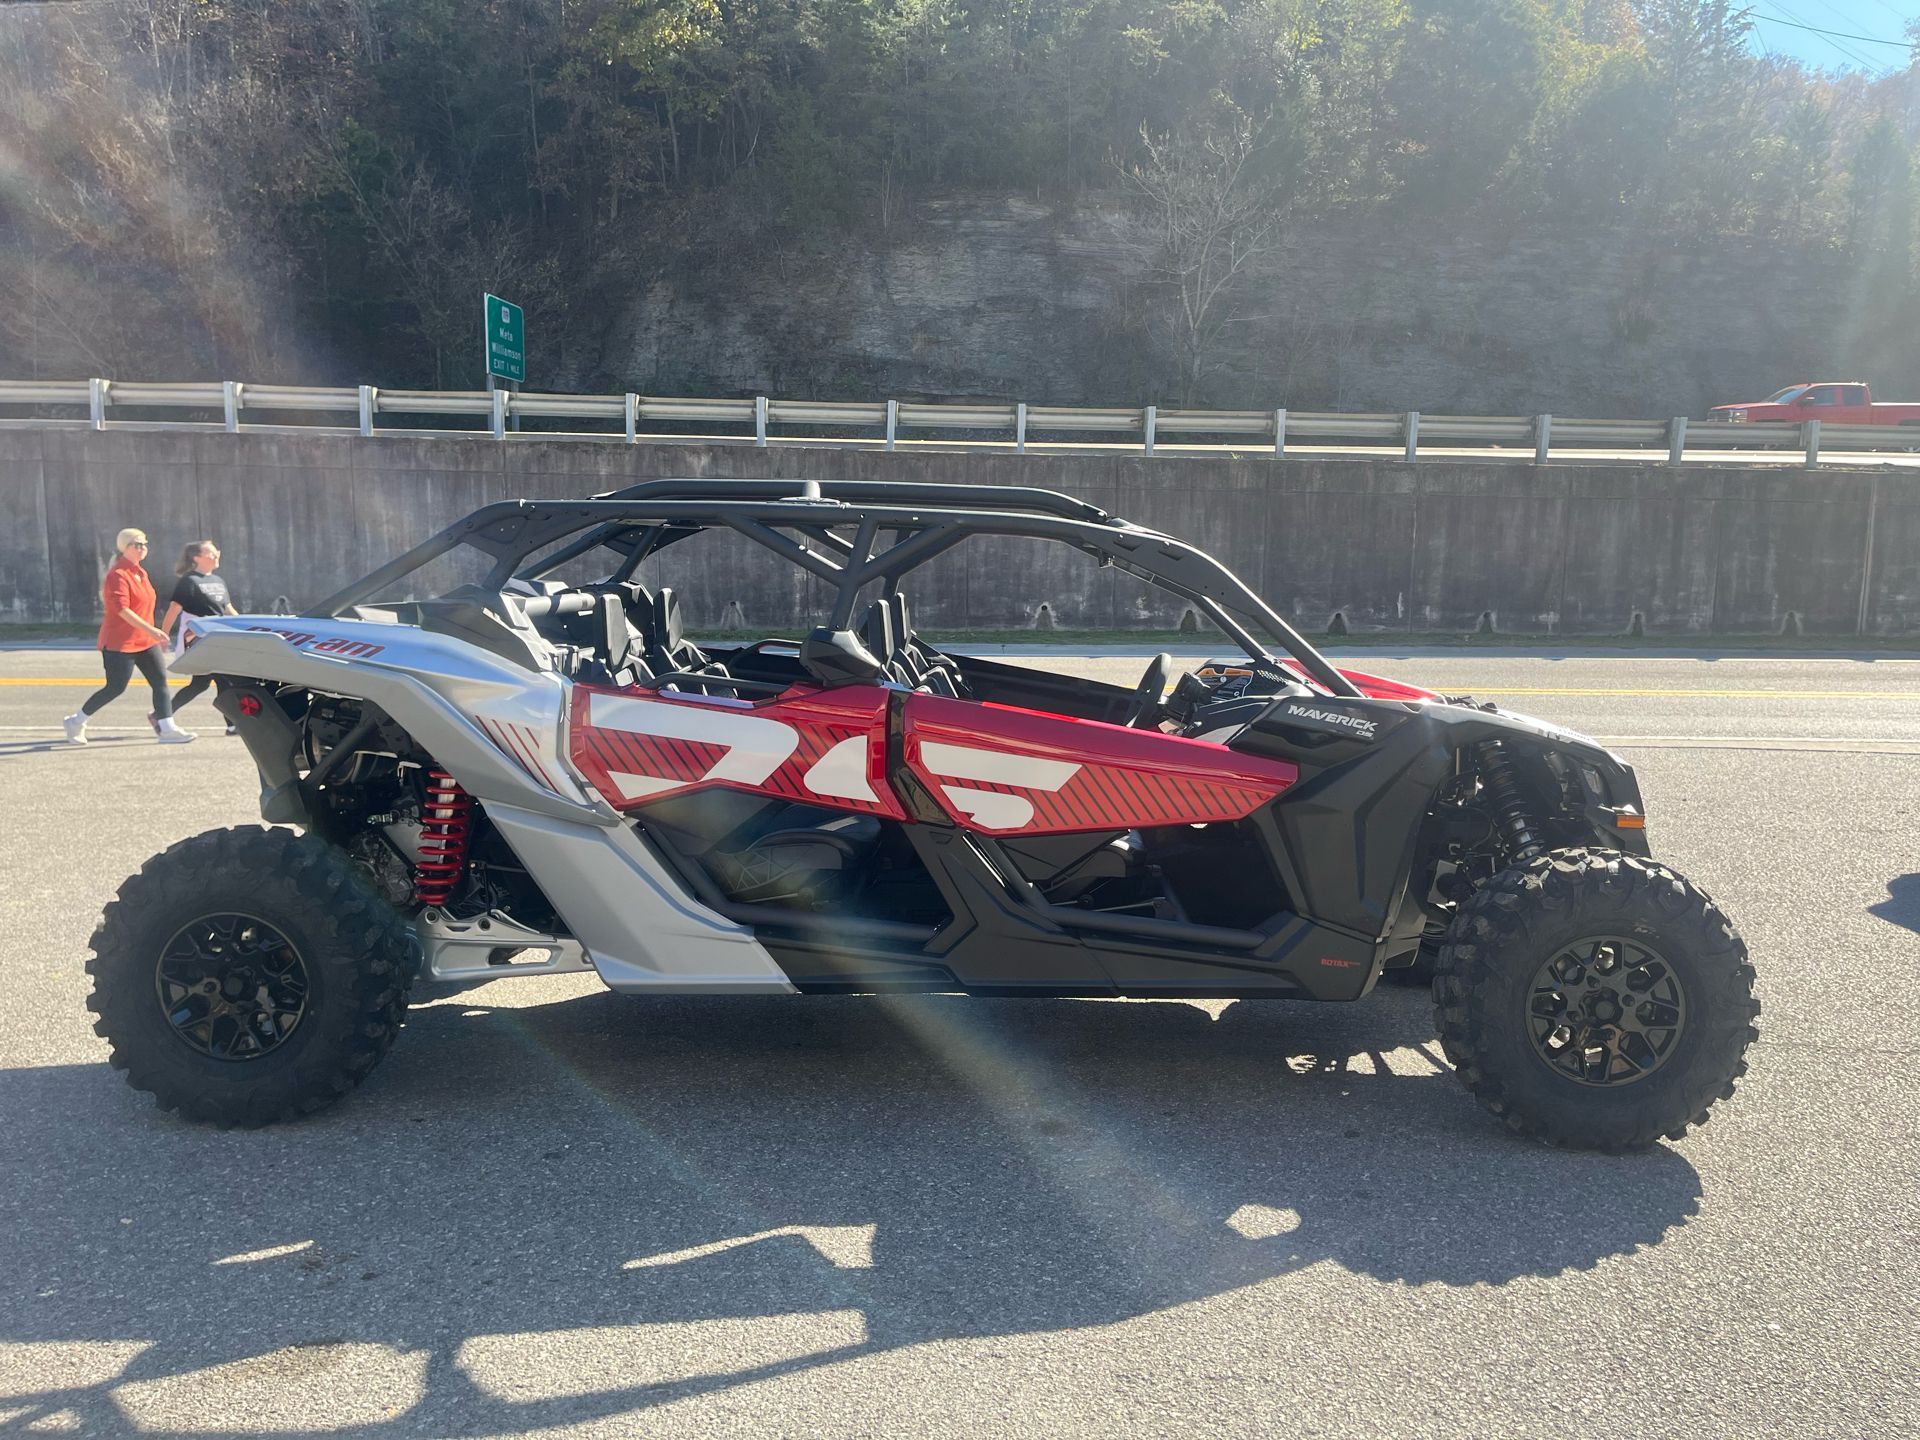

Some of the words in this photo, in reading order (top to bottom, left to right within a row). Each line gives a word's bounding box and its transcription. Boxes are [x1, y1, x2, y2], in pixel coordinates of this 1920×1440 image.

[499, 328, 513, 341] Meta
[491, 343, 521, 360] Williamson
[493, 358, 505, 370] EXIT
[510, 364, 520, 374] MILE
[1288, 704, 1379, 731] MAVERICK
[1321, 959, 1349, 968] ROTAX
